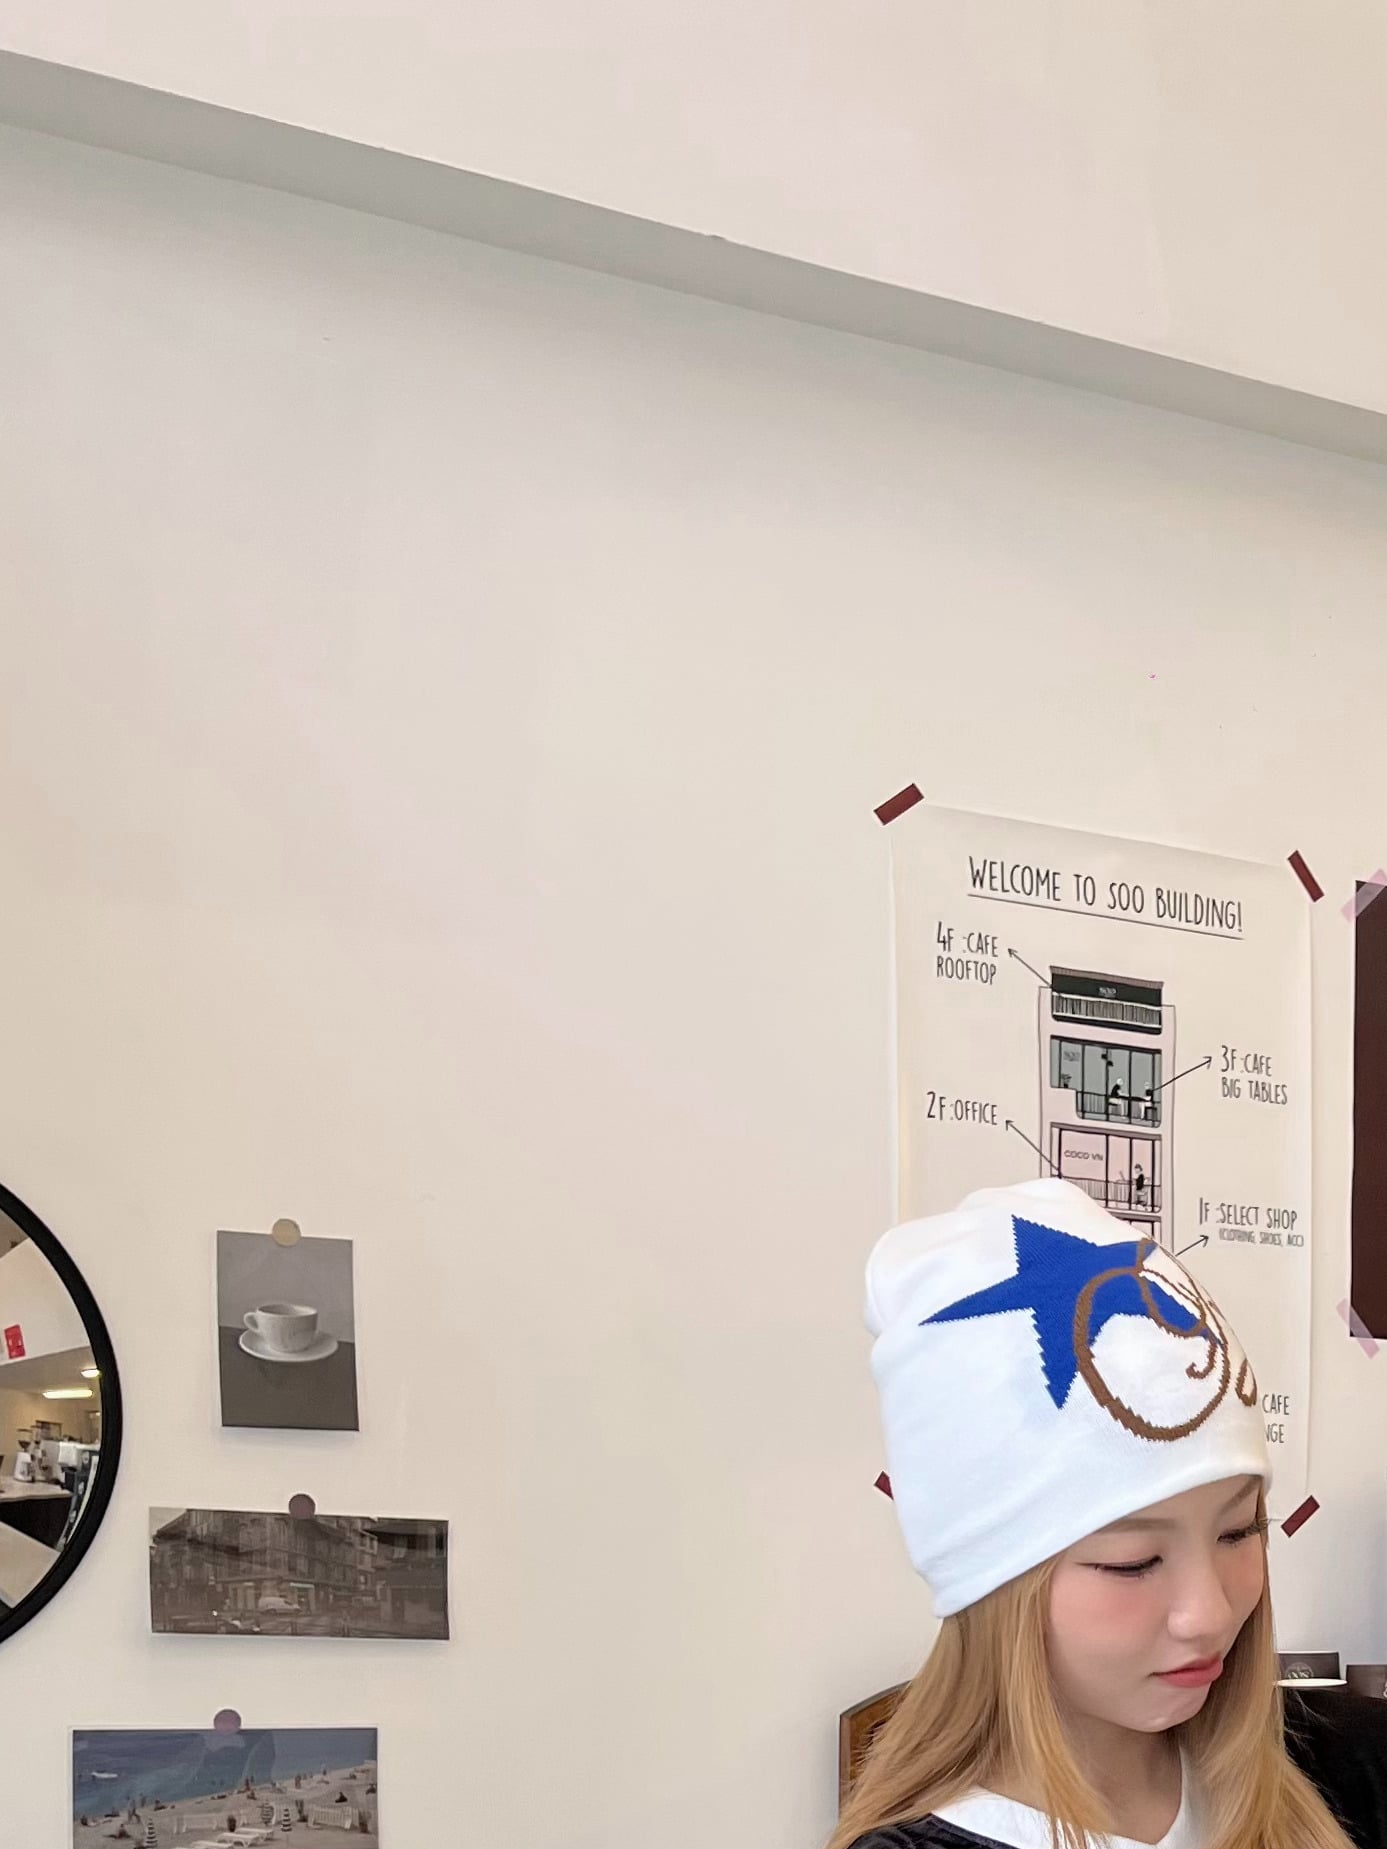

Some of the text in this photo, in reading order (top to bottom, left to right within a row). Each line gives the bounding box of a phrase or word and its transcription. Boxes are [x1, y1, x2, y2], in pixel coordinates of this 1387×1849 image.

[969, 856, 1243, 932] WELCOME TO SOO BUILDING!
[936, 921, 955, 952] 4F
[936, 956, 997, 985] ROOFTOP
[1221, 1045, 1237, 1072] 3F
[1221, 1076, 1288, 1105] BIG TABLES
[926, 1091, 946, 1120] 2F
[1063, 1149, 1090, 1161] COCO
[1266, 1207, 1298, 1231] SHOP
